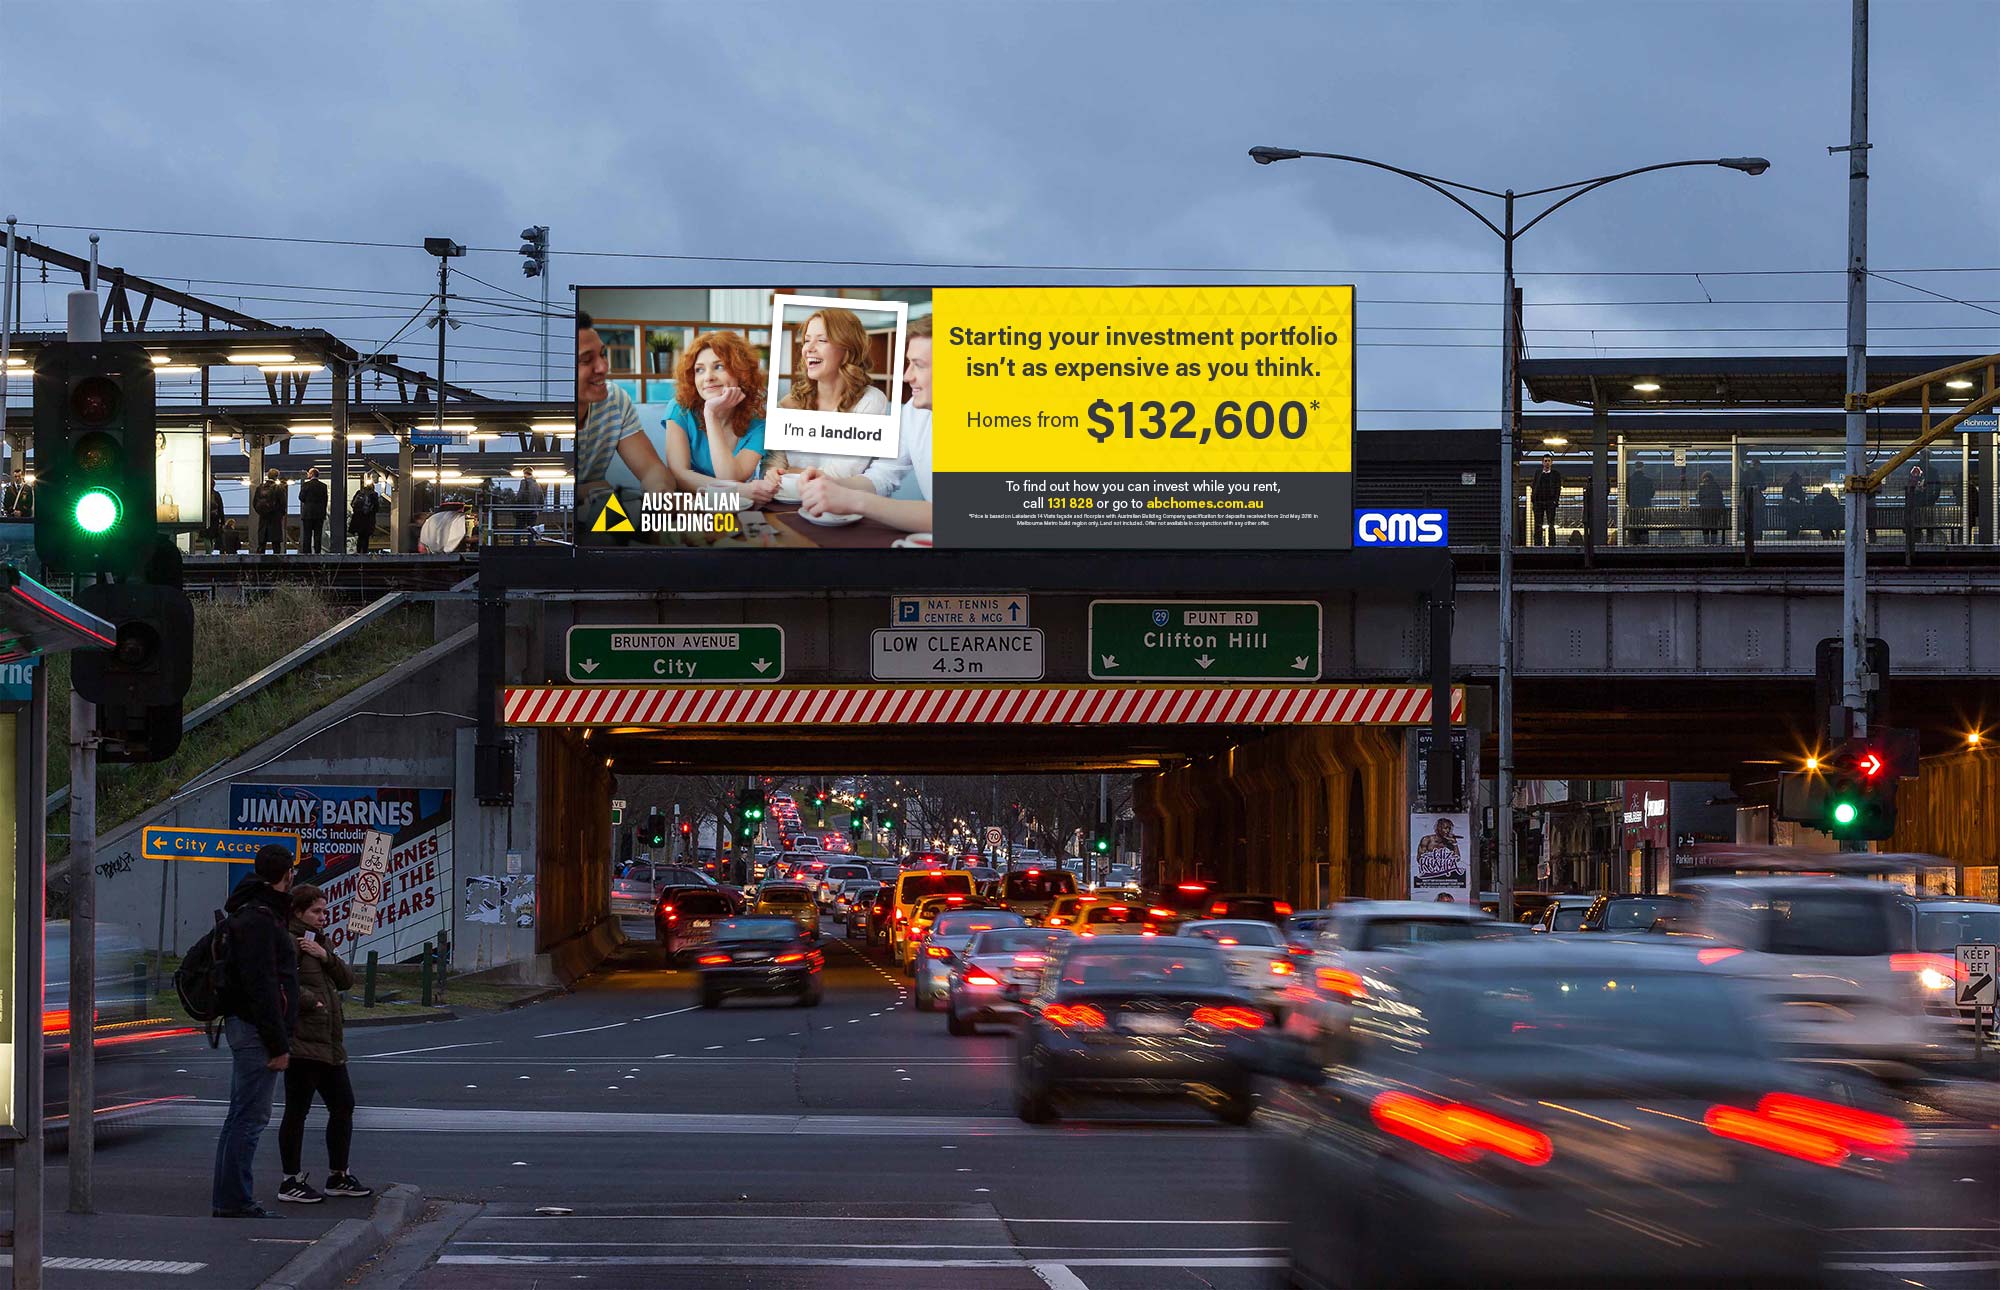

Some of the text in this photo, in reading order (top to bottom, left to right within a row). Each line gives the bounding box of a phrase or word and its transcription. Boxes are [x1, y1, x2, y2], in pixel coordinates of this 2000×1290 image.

[950, 325, 1338, 351] Starting your investment portfolio
[966, 356, 1321, 382] isn't as expensive as you think.
[967, 411, 1032, 428] Homes
[1036, 410, 1079, 428] from
[1963, 419, 1997, 427] Richmond
[784, 423, 882, 442] I'm a landlord
[1005, 479, 1281, 495] To find out how you can invest while you rent,
[641, 492, 740, 511] AUSTRALIAN
[1023, 496, 1264, 512] call 131 828 or go to abchomes.com.au
[1359, 513, 1443, 542] QMS
[903, 605, 915, 619] P
[928, 599, 999, 610] NAT. TENNIS
[924, 613, 1003, 624] CENTRE & MCG
[1153, 611, 1168, 623] 29
[1188, 611, 1254, 625] PUNT RD
[614, 635, 737, 649] BRUNTON AVENUE
[883, 636, 1033, 652] LOW CLEARANCE
[1143, 632, 1268, 649] Clifton Hill
[652, 658, 698, 678] City
[237, 798, 413, 826] JIMMY BARNES
[330, 829, 366, 840] includin
[990, 832, 999, 840] 70
[1678, 836, 1684, 847] P
[174, 837, 261, 854] City Acces
[312, 842, 363, 854] RECORDIN
[368, 845, 385, 855] ALL
[386, 835, 438, 874] ARNES
[322, 898, 355, 928] BES
[399, 861, 436, 892] THE
[376, 886, 435, 928] YEARS
[351, 909, 374, 923] BRUNTON
[350, 920, 371, 932] AVENUE
[1963, 949, 1991, 960] KEEP
[1964, 962, 1990, 972] LEFT
